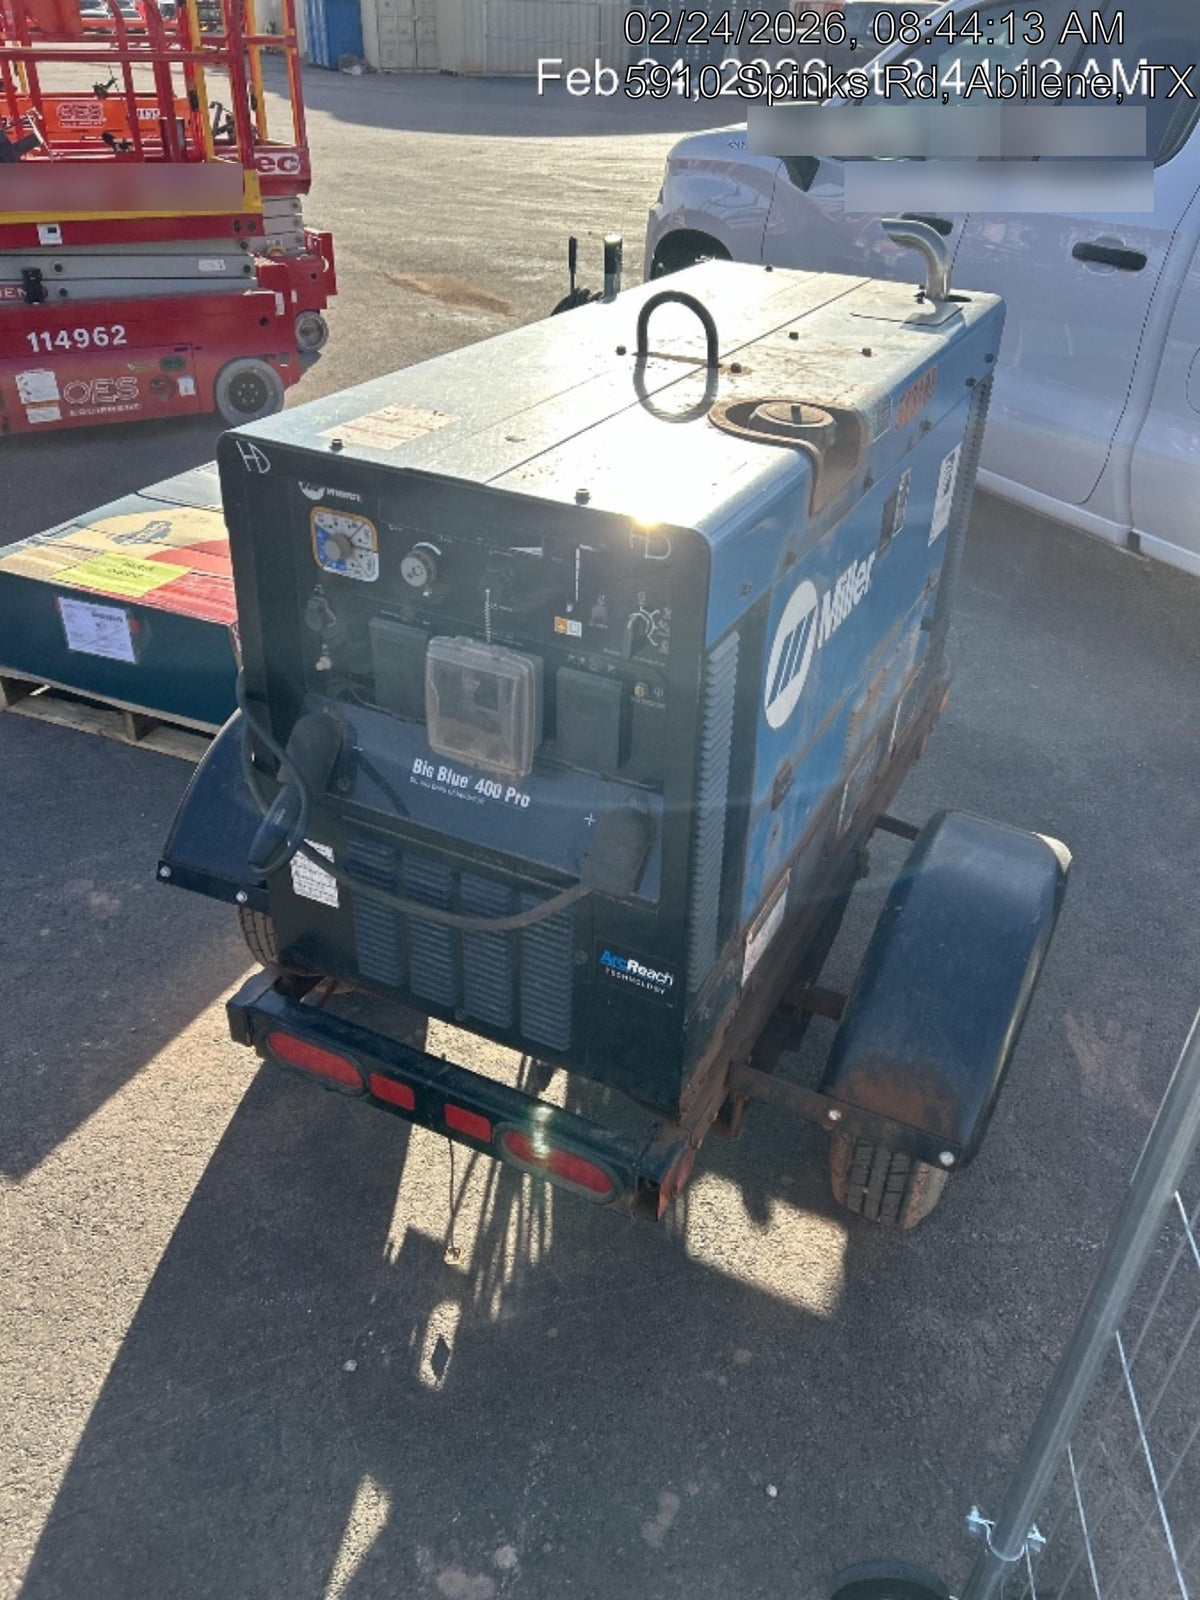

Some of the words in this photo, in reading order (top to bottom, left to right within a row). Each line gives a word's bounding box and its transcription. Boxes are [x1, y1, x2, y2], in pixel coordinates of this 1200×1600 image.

[26, 324, 128, 353] 114962
[63, 376, 140, 405] OES
[817, 550, 877, 650] Miller
[412, 757, 435, 779] Big
[436, 765, 470, 789] Blue
[474, 777, 502, 799] 400
[504, 786, 531, 808] Pro
[600, 949, 674, 987] ArcReach
